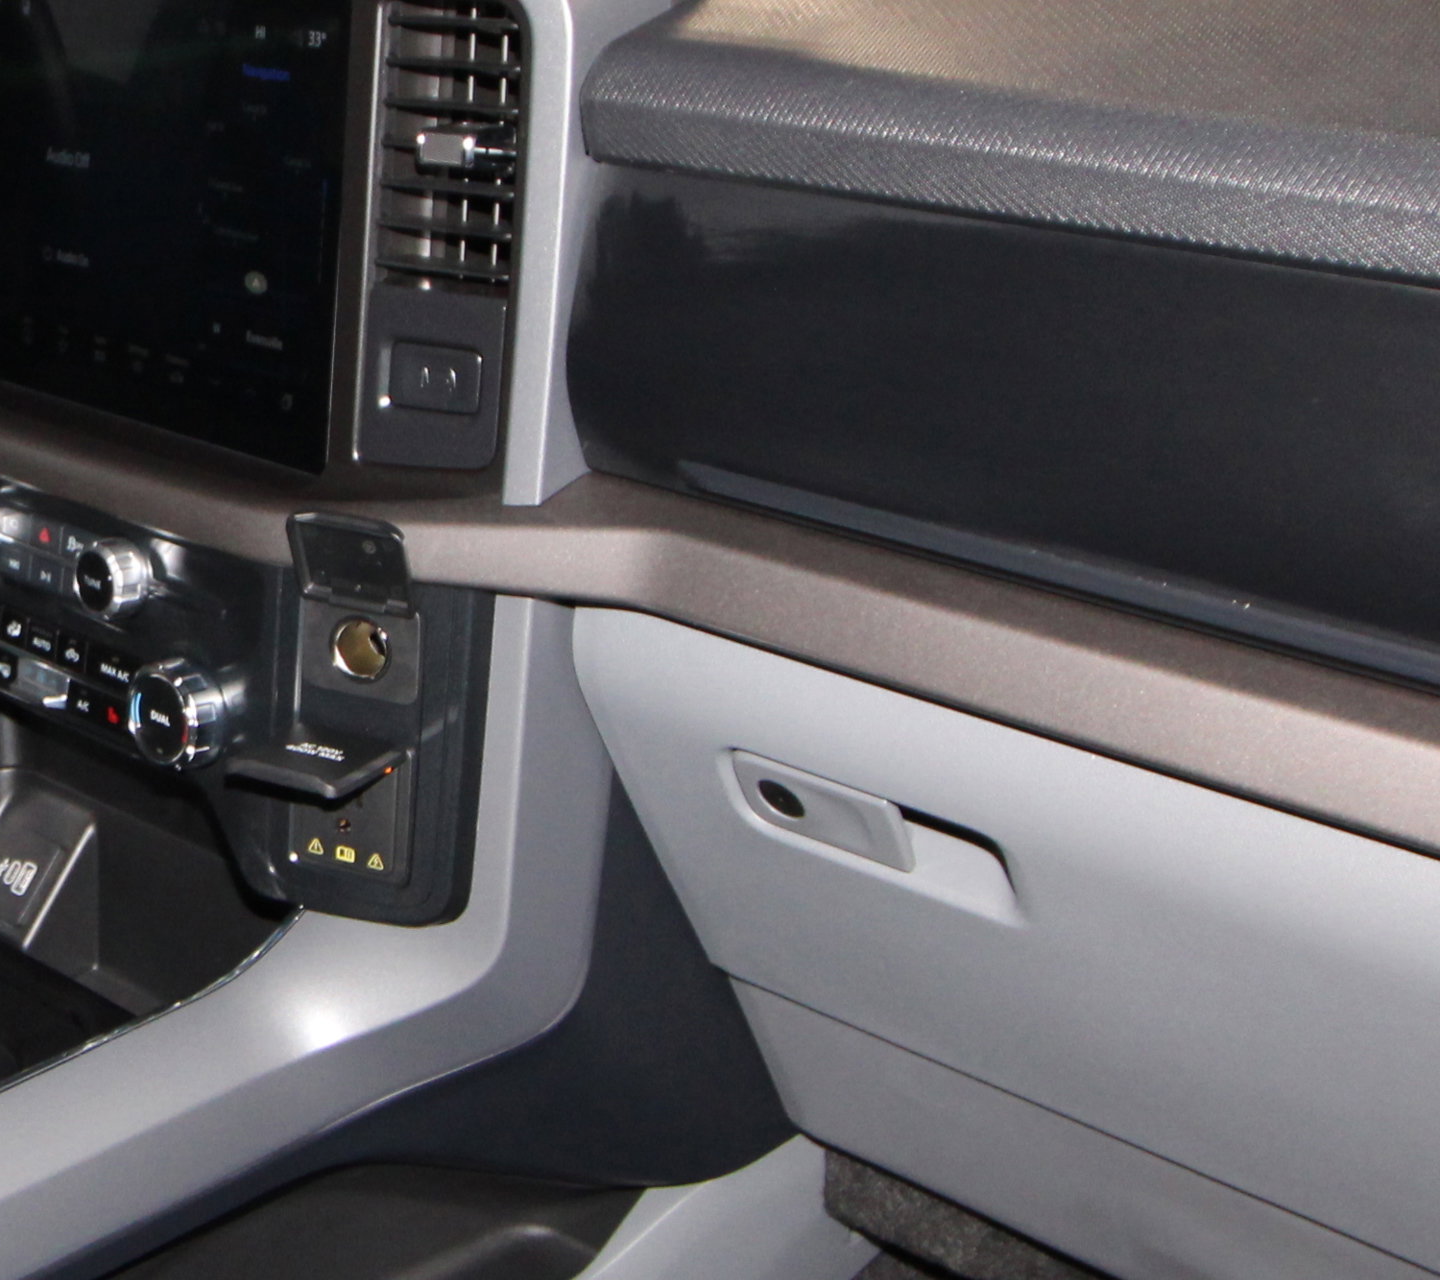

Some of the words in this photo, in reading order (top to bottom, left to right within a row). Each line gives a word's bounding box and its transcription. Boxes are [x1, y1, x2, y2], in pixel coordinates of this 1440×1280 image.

[255, 24, 266, 40] HI
[32, 636, 52, 652] AUTO
[100, 663, 117, 678] MAX
[117, 670, 130, 684] A/C
[76, 698, 91, 713] A/C
[150, 708, 171, 728] DUAL
